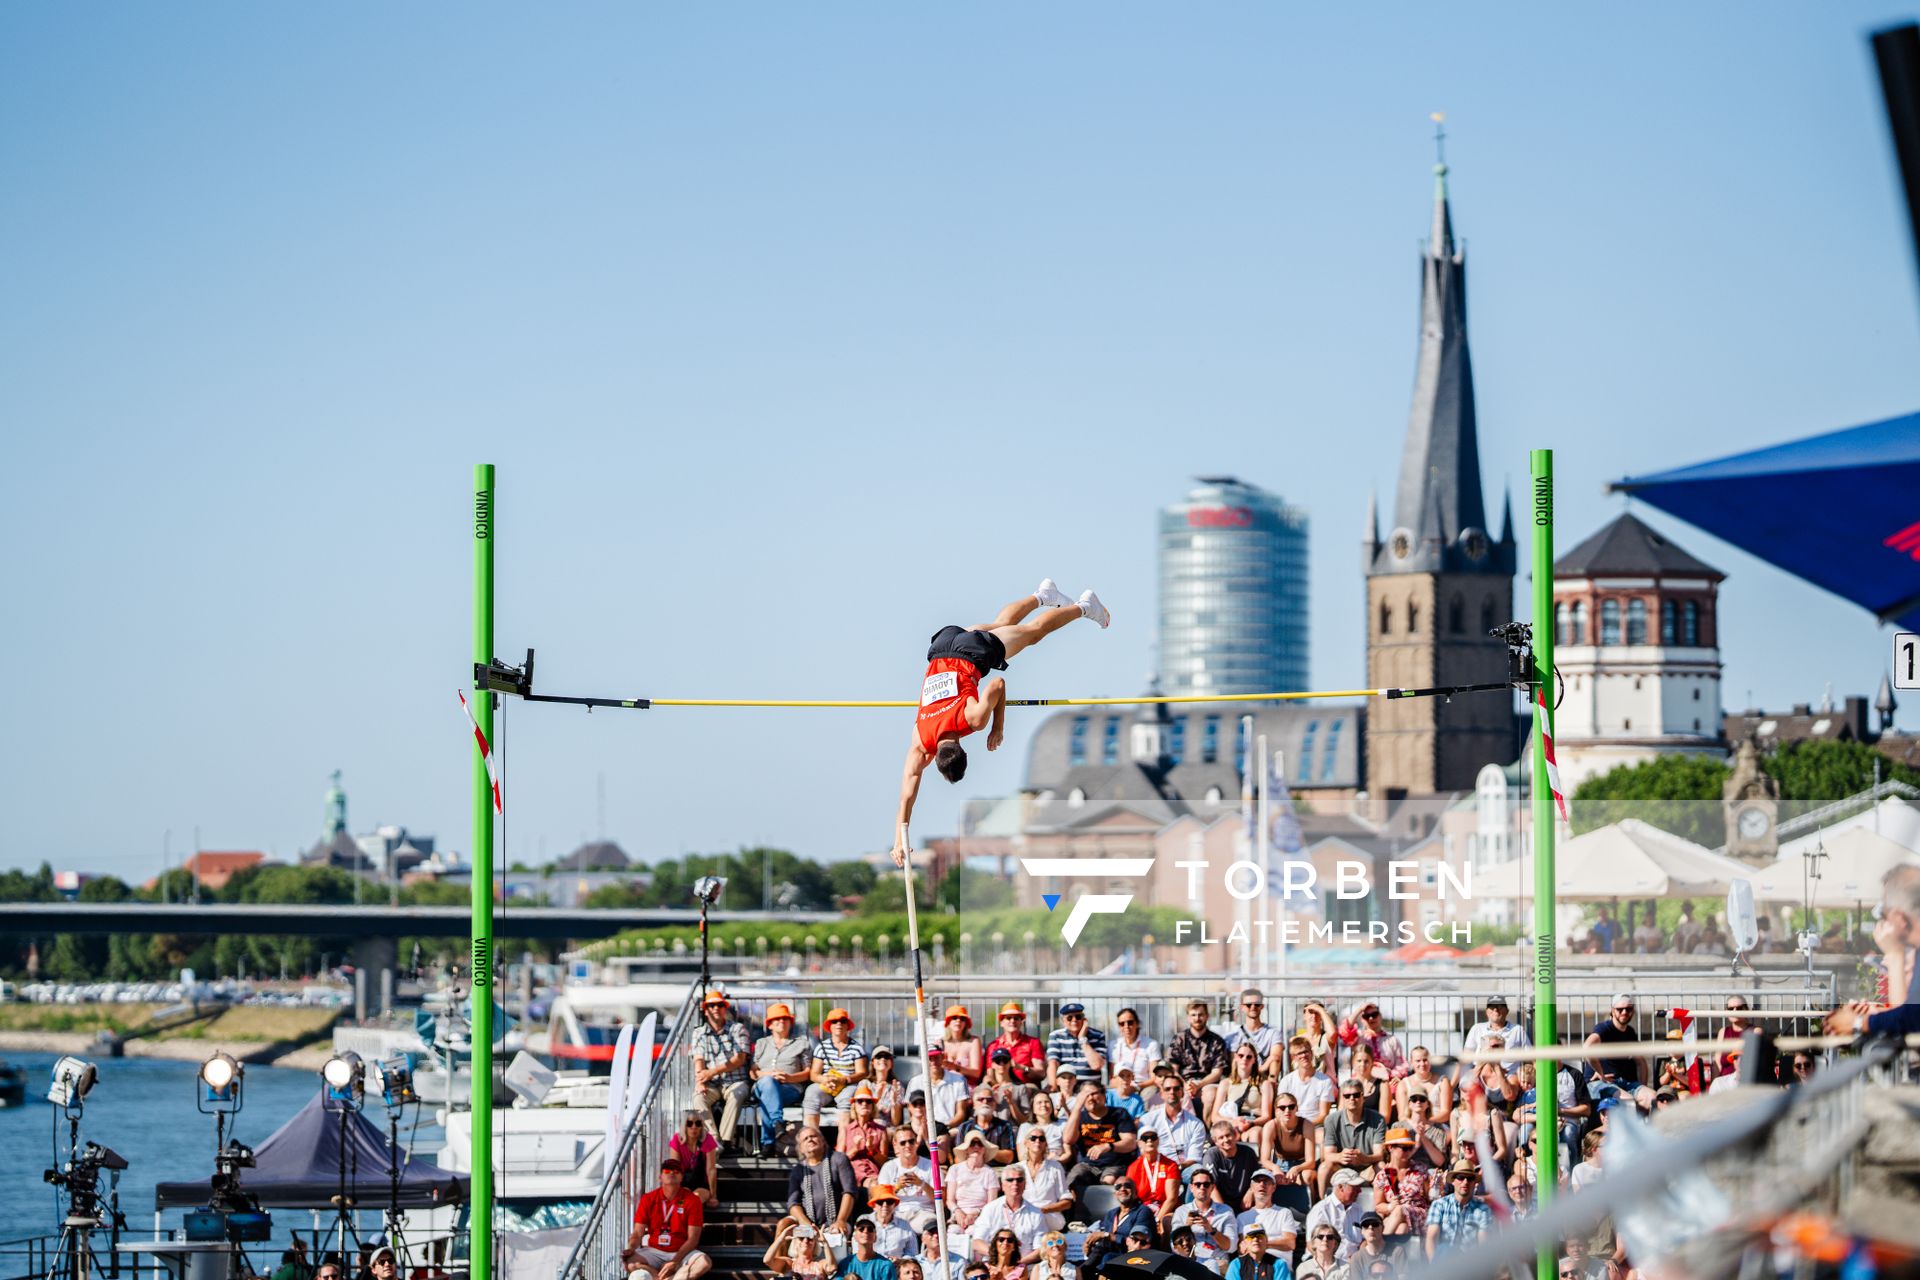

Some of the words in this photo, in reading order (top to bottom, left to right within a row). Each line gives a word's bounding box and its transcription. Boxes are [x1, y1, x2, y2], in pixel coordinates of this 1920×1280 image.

[475, 490, 489, 540] VINDICO
[1535, 476, 1549, 526] VINDICO
[924, 678, 954, 697] LADWIG
[931, 689, 950, 702] GLS
[474, 937, 487, 987] VINDICO
[1538, 934, 1552, 985] VINDICO
